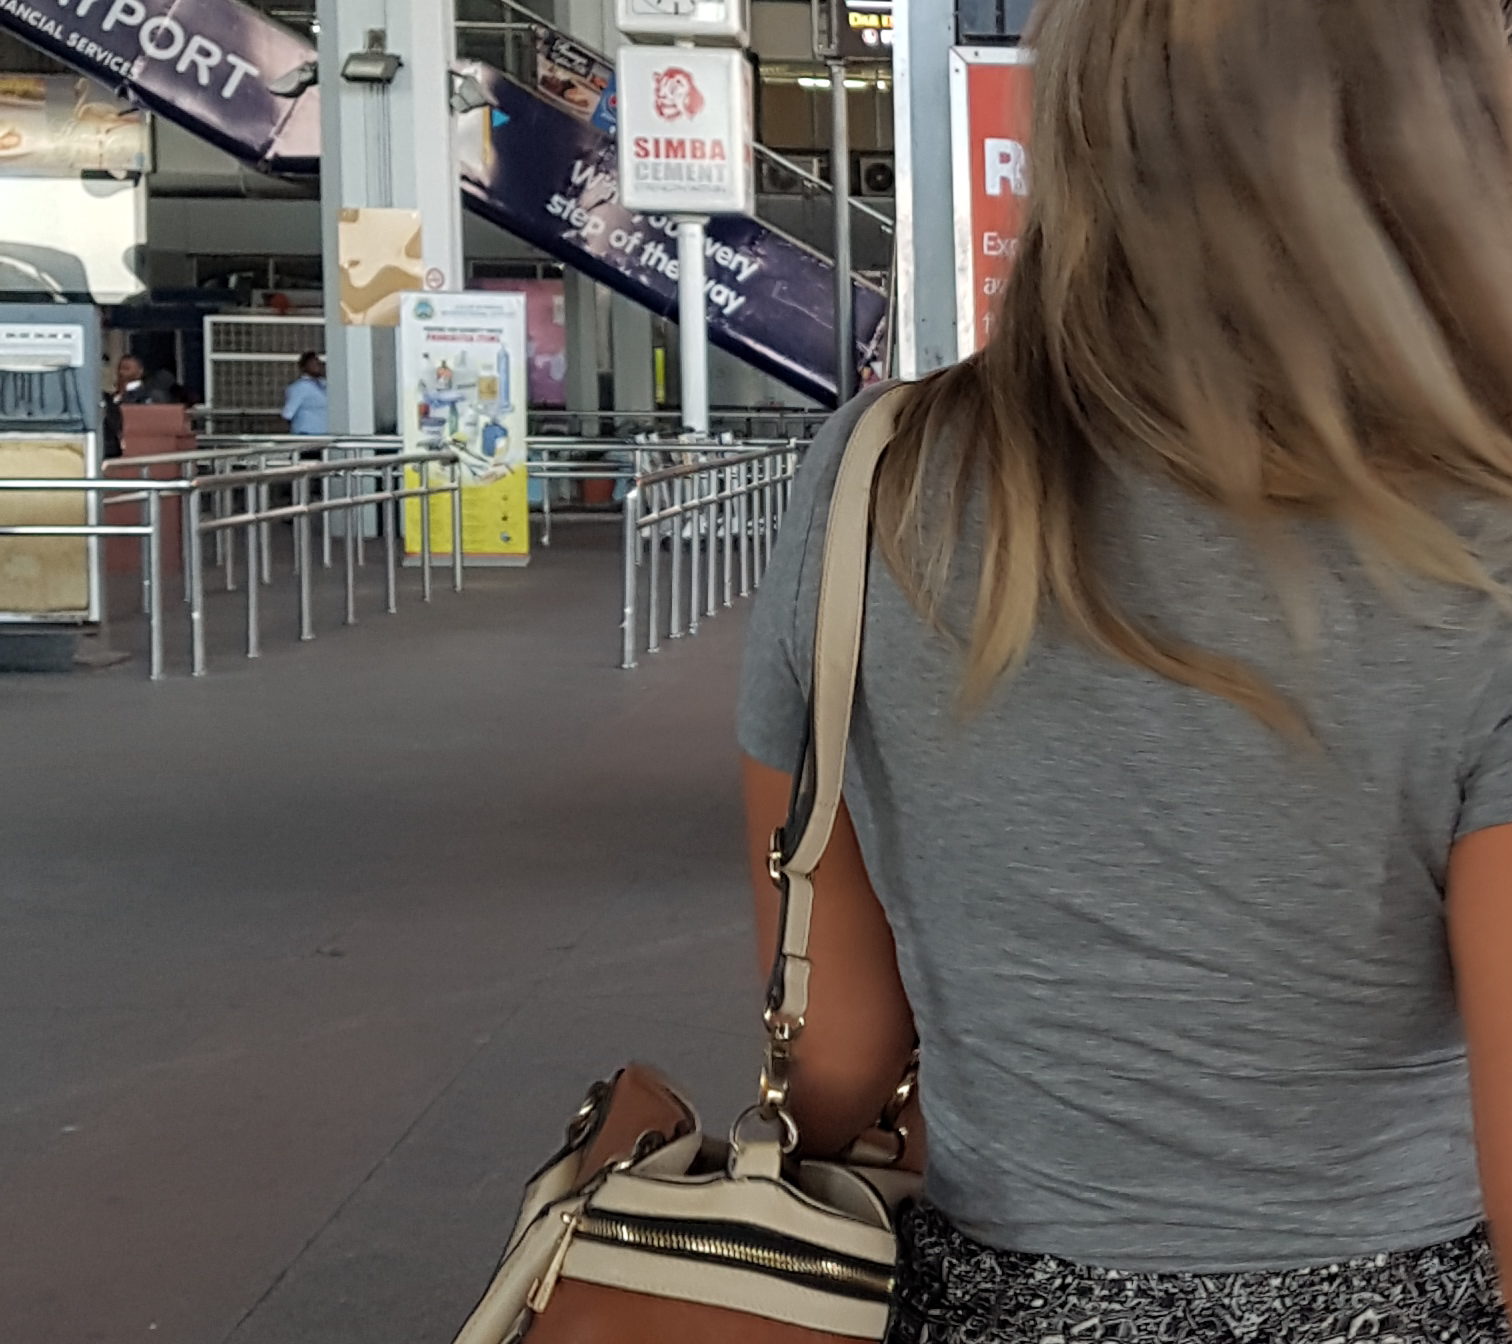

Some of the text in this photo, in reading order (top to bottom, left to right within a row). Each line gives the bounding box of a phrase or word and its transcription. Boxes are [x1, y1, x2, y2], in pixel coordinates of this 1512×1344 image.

[634, 136, 726, 161] SIMBA
[634, 161, 727, 184] CEMENT
[609, 228, 643, 255] of
[640, 240, 681, 282] the
[704, 235, 761, 282] very
